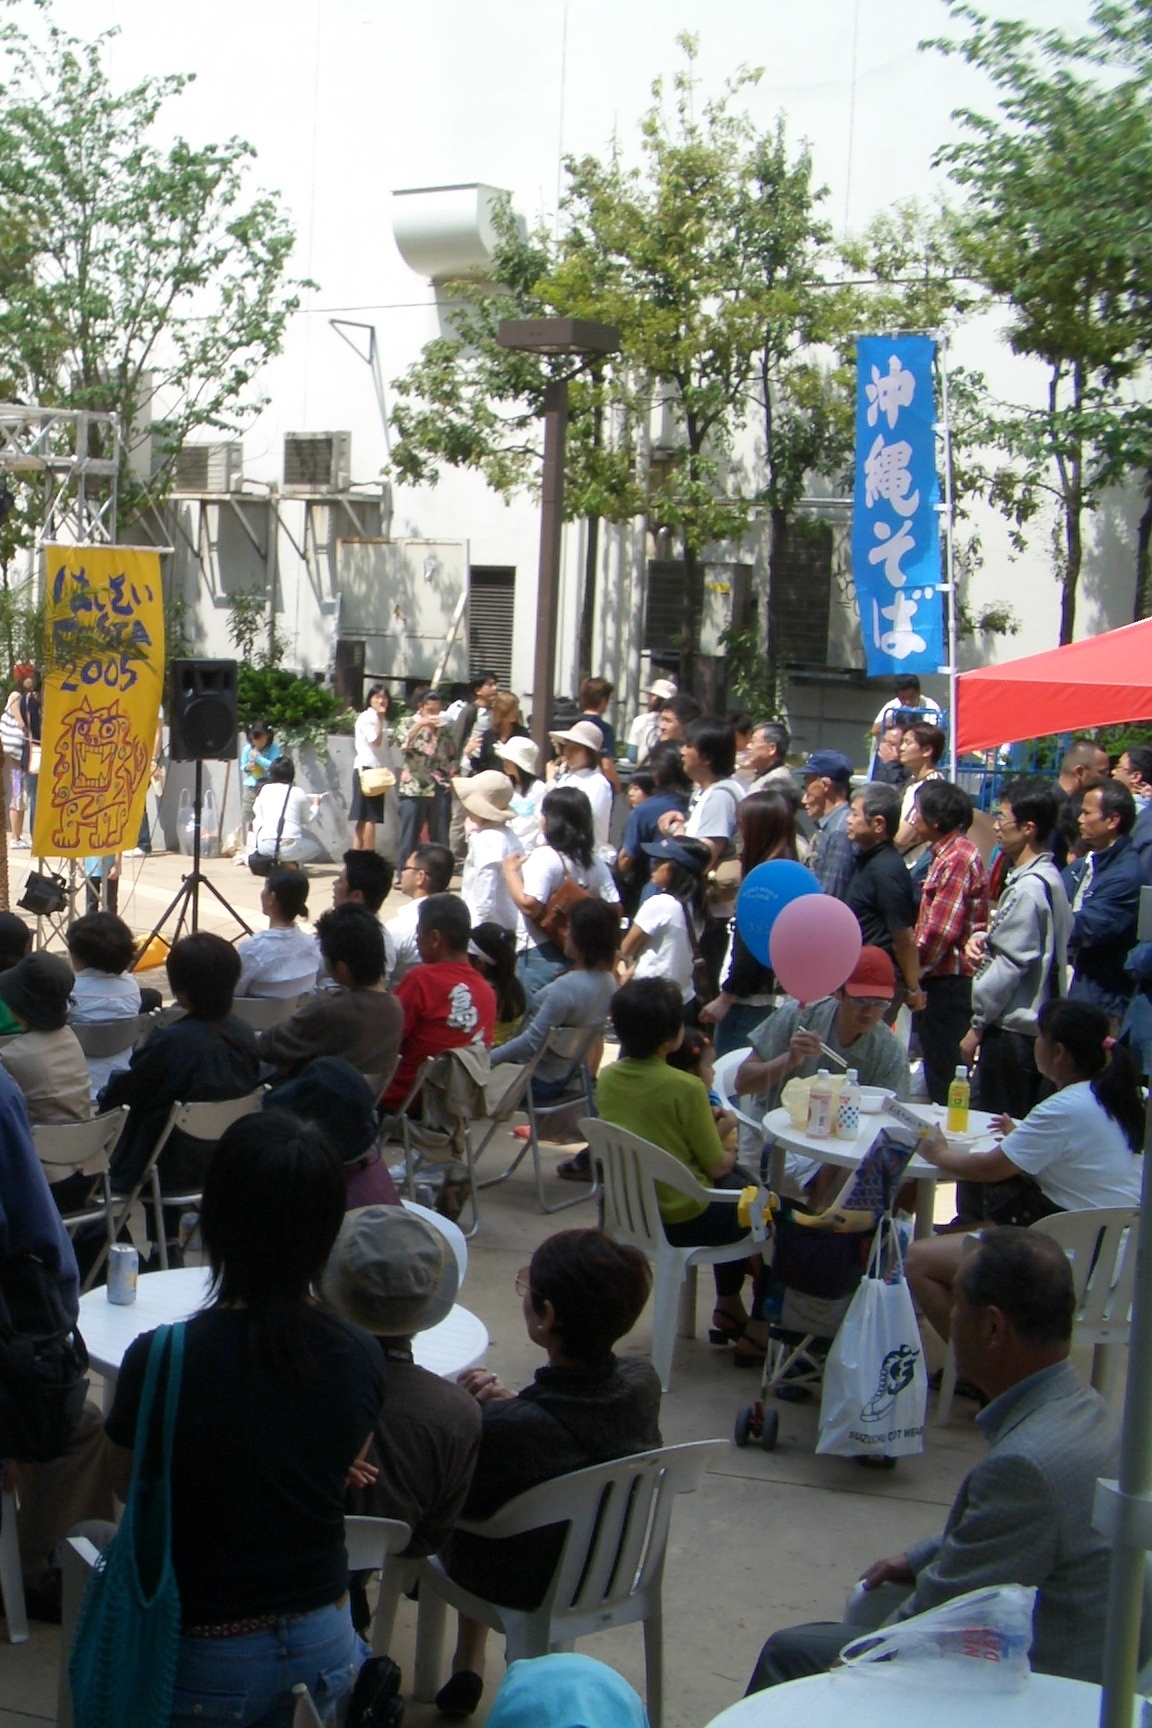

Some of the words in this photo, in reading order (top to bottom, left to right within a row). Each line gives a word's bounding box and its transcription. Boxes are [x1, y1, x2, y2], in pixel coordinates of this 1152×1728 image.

[865, 354, 934, 660] 沖縄そば
[60, 653, 144, 692] 2005
